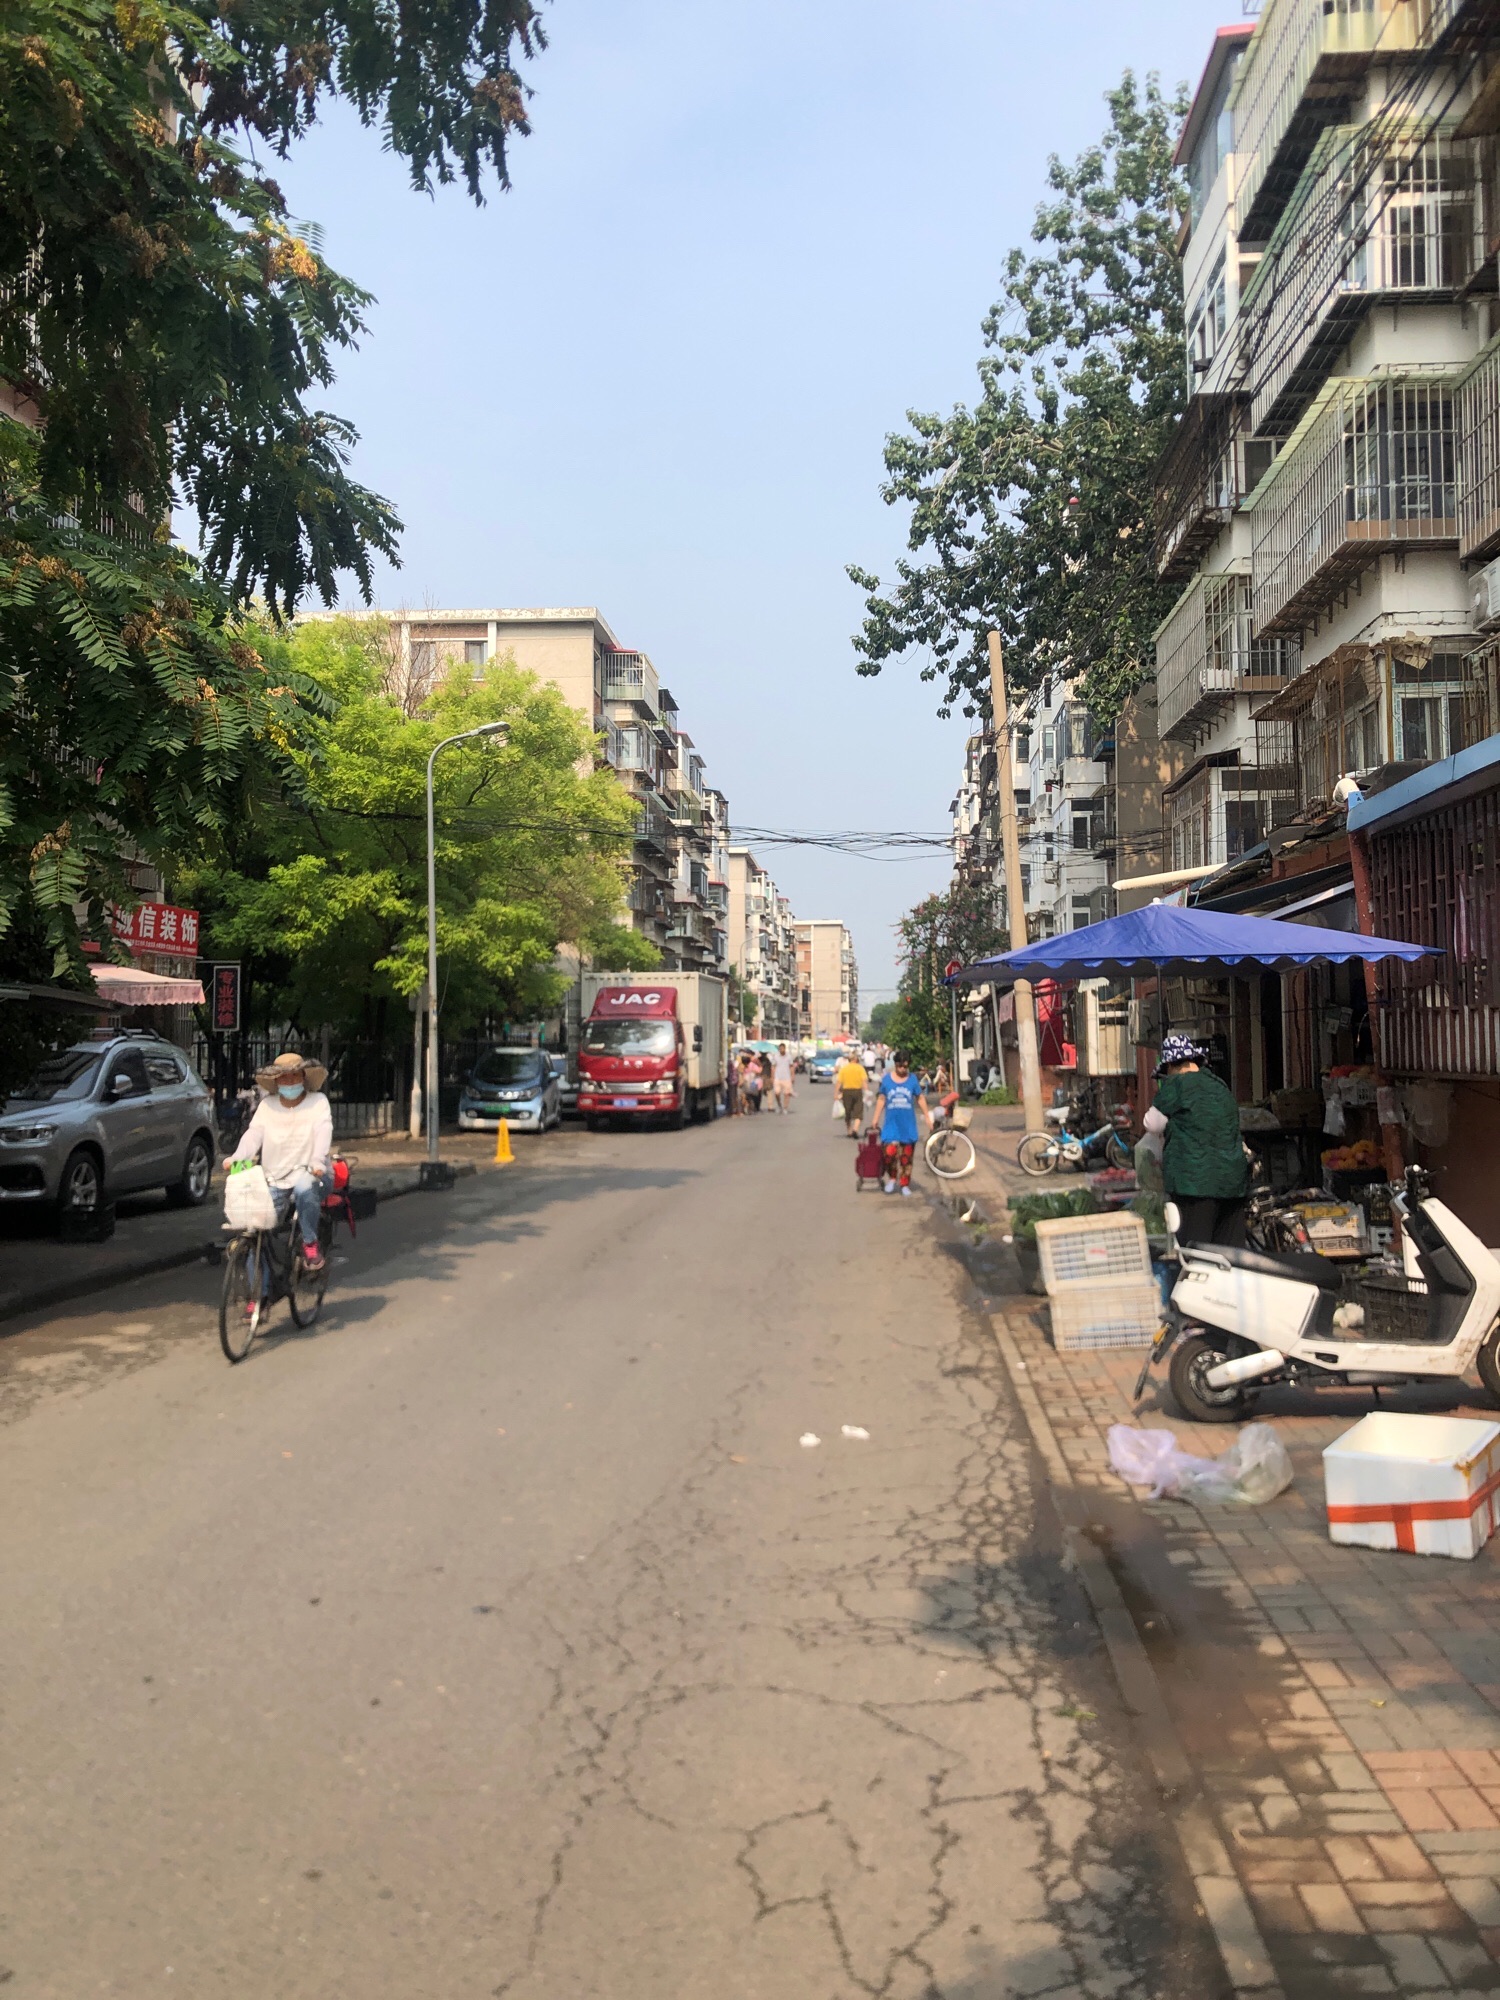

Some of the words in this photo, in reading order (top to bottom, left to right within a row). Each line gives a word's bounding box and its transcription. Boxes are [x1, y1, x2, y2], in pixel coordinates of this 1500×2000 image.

[217, 971, 235, 1026] 专业装修
[610, 993, 661, 1005] JAC
